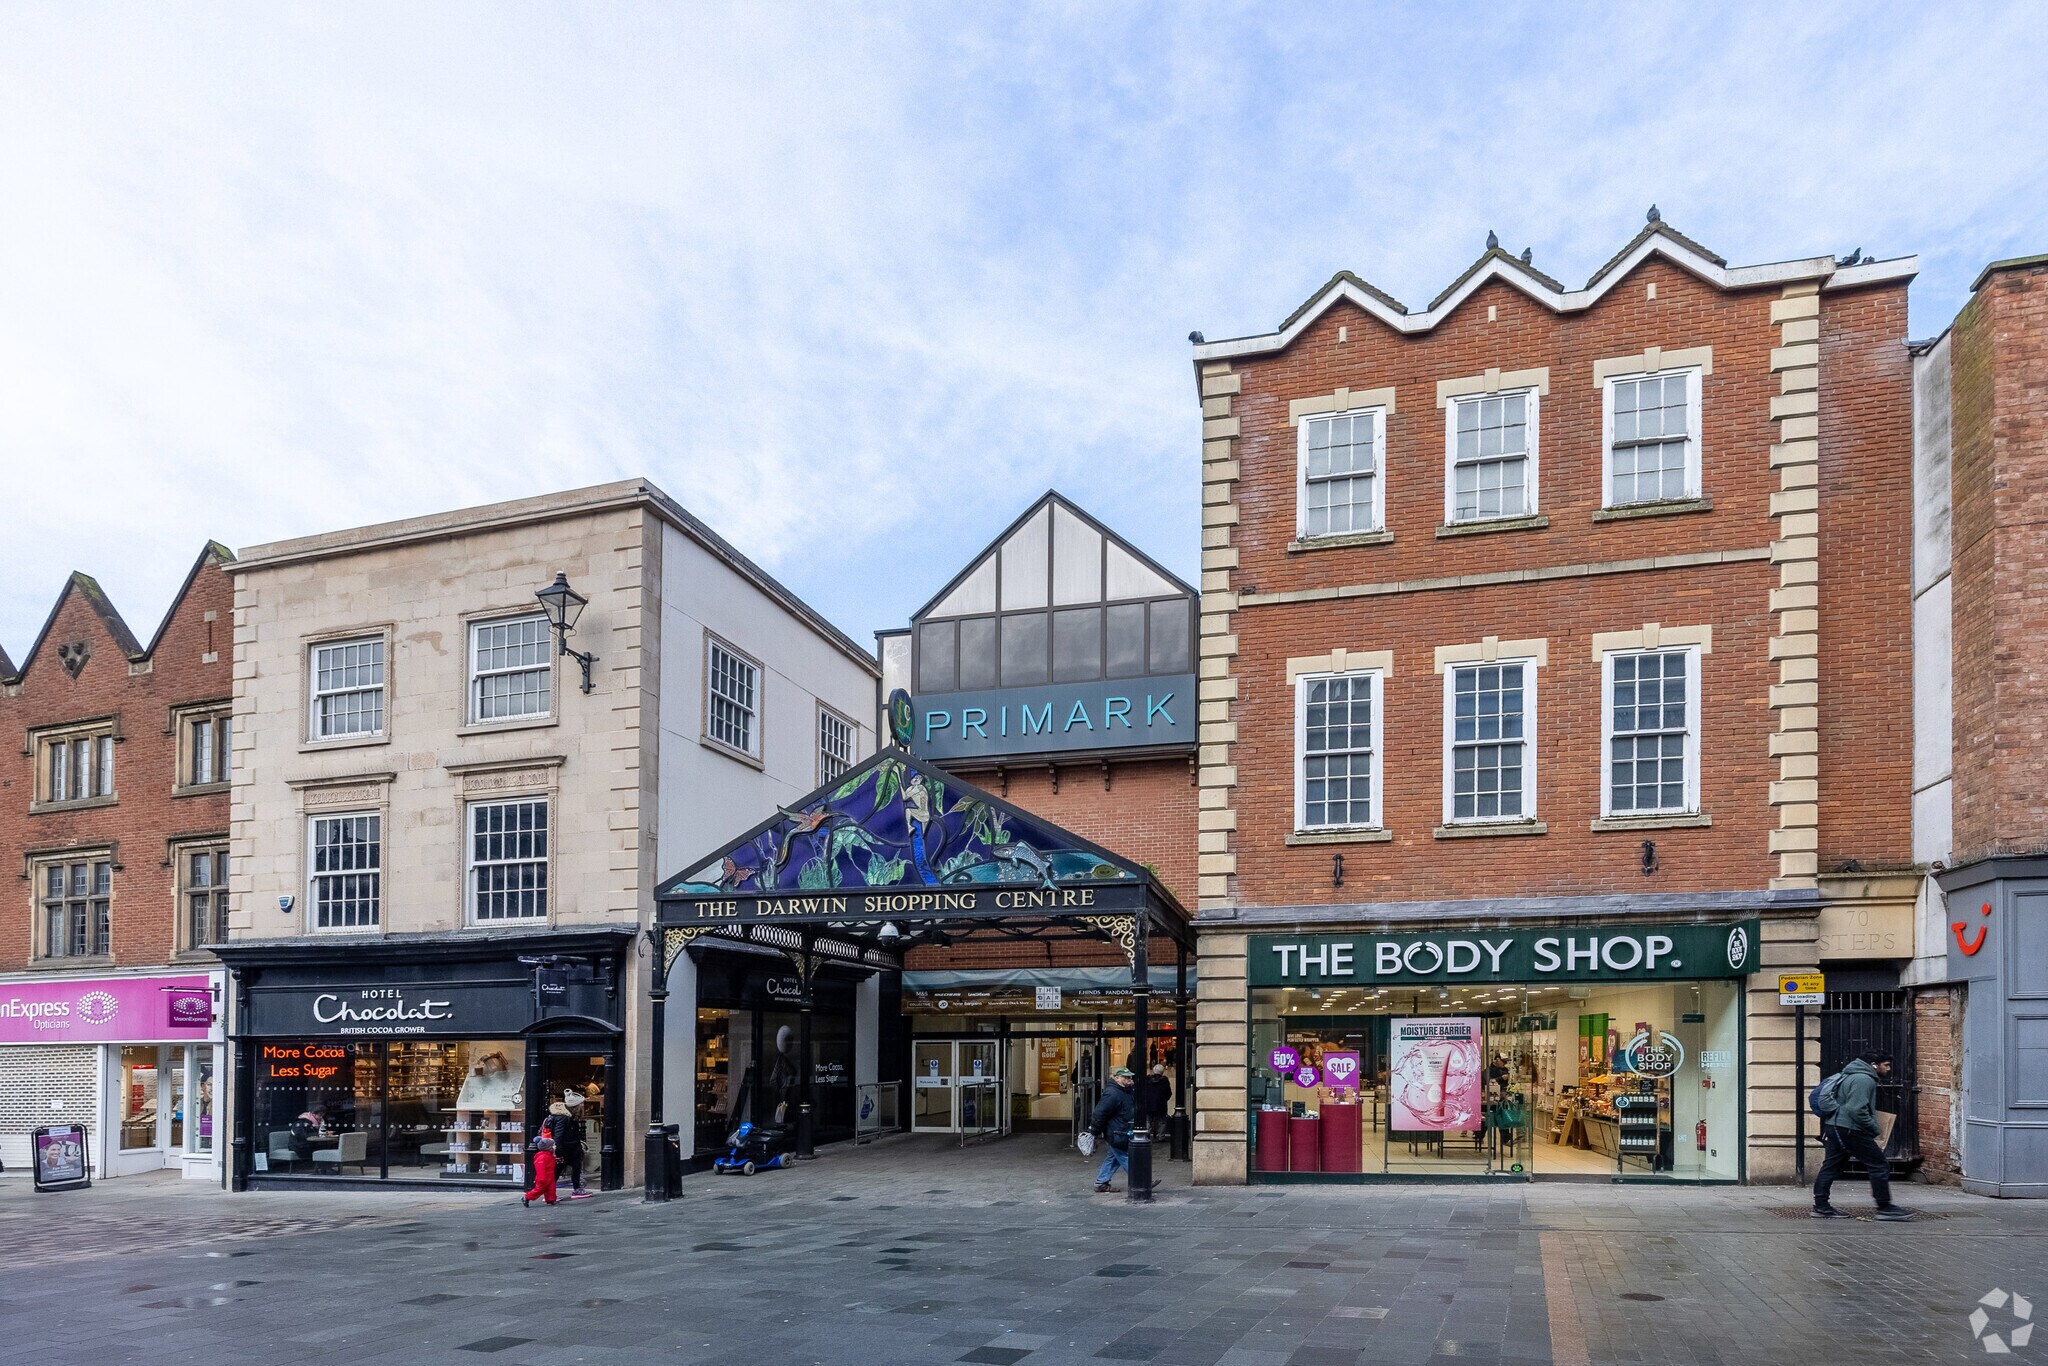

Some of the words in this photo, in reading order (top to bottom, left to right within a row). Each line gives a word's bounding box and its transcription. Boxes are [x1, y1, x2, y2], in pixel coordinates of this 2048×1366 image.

[925, 692, 1176, 742] PRIMARK
[694, 901, 738, 918] THE
[756, 897, 848, 916] DARWIN
[864, 893, 977, 913] SHOPPING
[995, 889, 1096, 909] CENTRE
[1846, 910, 1869, 927] 70
[1819, 933, 1896, 951] STEPS
[1272, 943, 1354, 977] THE
[1375, 939, 1514, 975] BODY
[362, 989, 402, 999] HOTEL
[313, 994, 453, 1023] Chocolat.
[33, 1019, 71, 1031] Opticians
[366, 1026, 393, 1034] COCOA
[1400, 1026, 1438, 1036] MOISTURE
[1439, 1025, 1472, 1036] BARRIER
[263, 1046, 301, 1059] More
[303, 1045, 345, 1058] Cocoa
[1637, 1053, 1673, 1062] BODY
[1702, 1052, 1728, 1061] REFILL
[1273, 1053, 1295, 1066] 50%
[270, 1064, 300, 1077] Less
[303, 1063, 338, 1079] Sugar
[815, 1064, 828, 1072] More
[1331, 1063, 1351, 1073] SALE
[1638, 1062, 1672, 1070] SHOP
[815, 1075, 826, 1083] Less
[826, 1074, 838, 1084] Sugar
